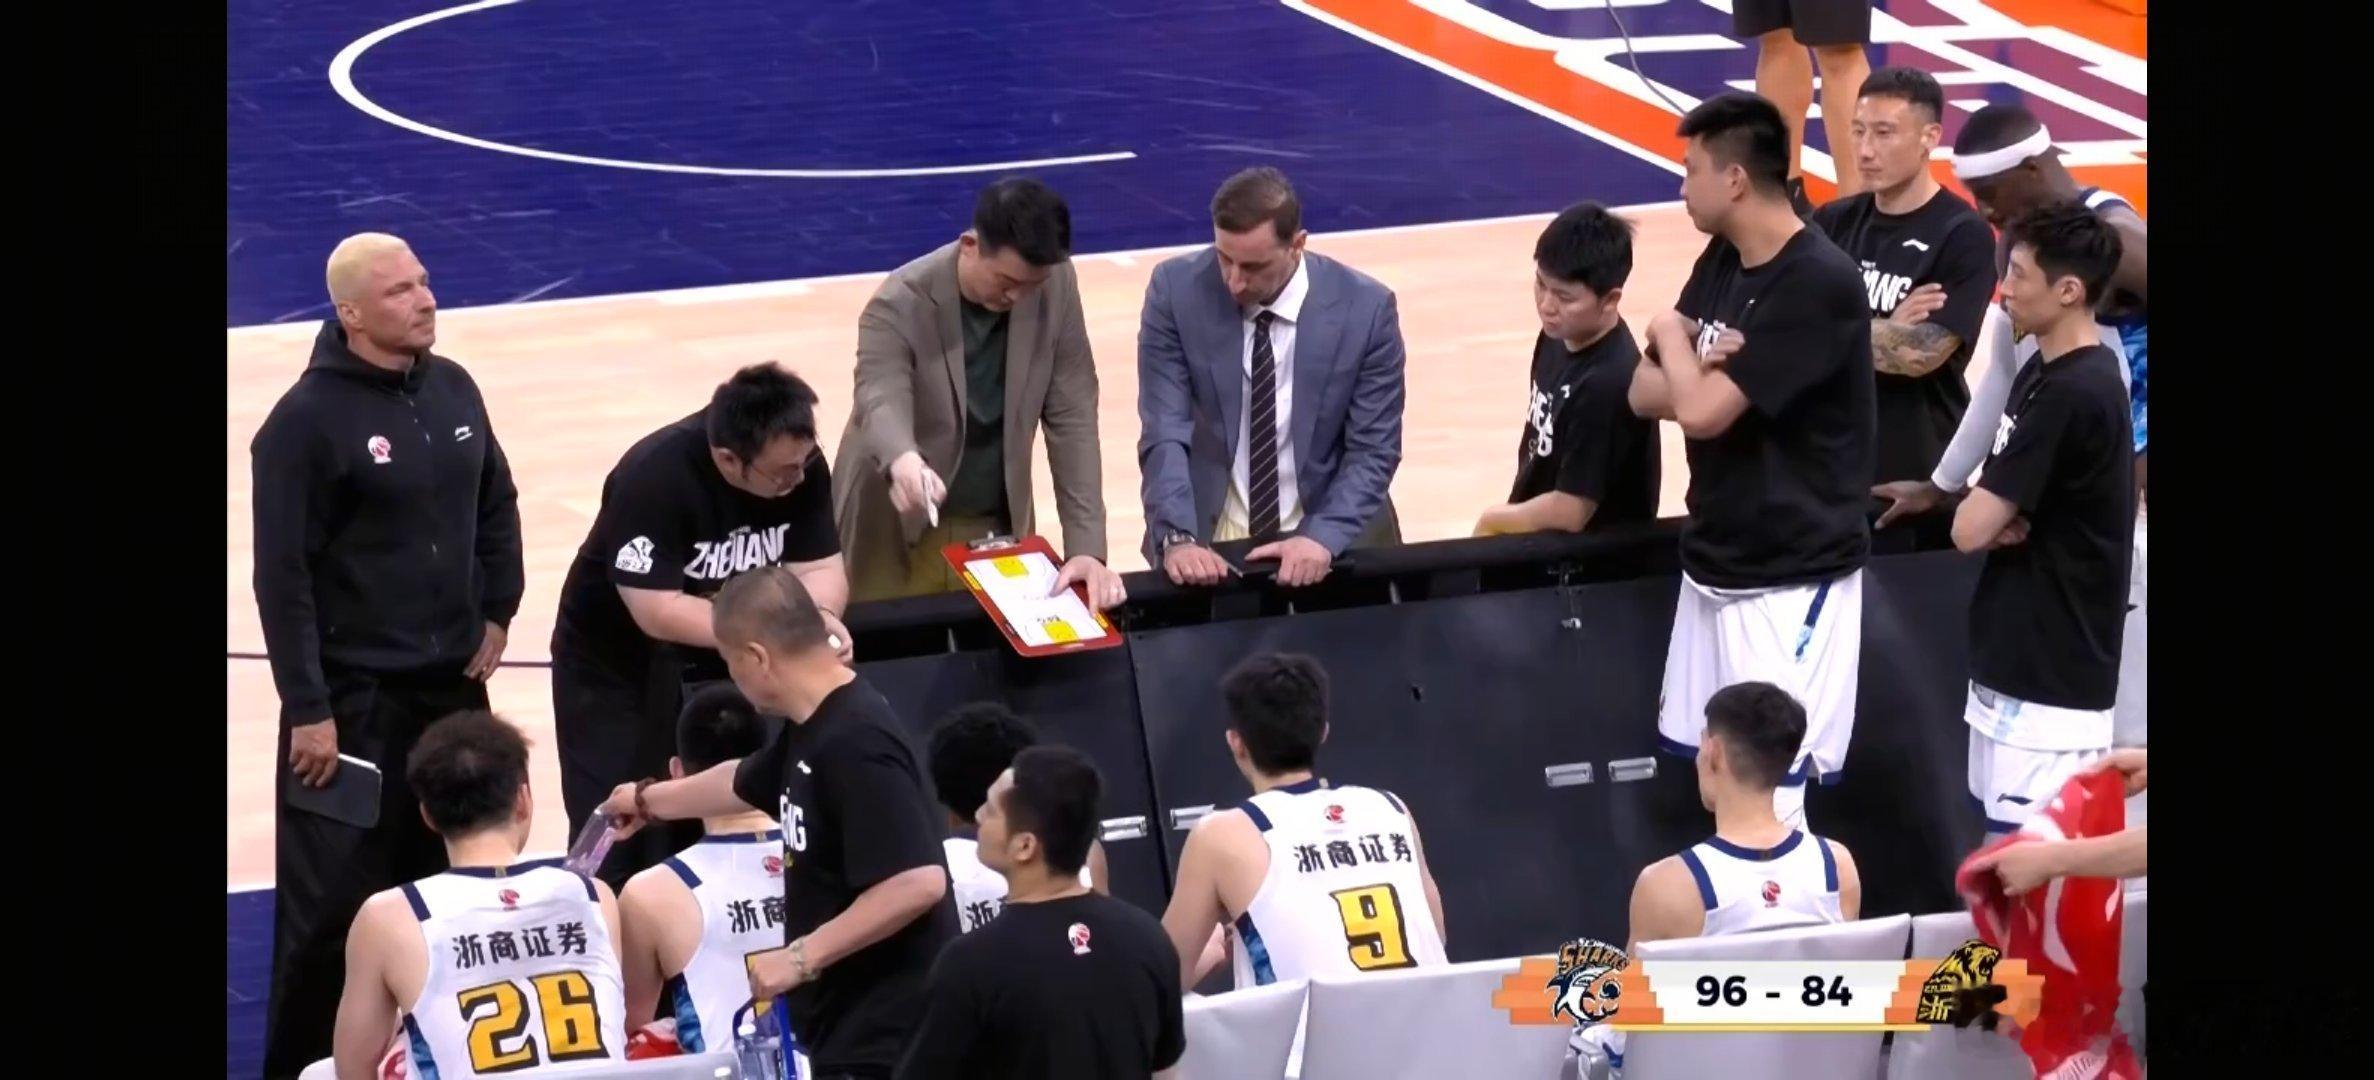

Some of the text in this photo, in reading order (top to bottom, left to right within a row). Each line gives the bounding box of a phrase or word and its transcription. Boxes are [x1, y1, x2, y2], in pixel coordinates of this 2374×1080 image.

[1293, 833, 1412, 873] 浙商证券
[452, 921, 588, 969] 浙商证券
[1329, 882, 1419, 973] 9
[456, 969, 611, 1075] 26
